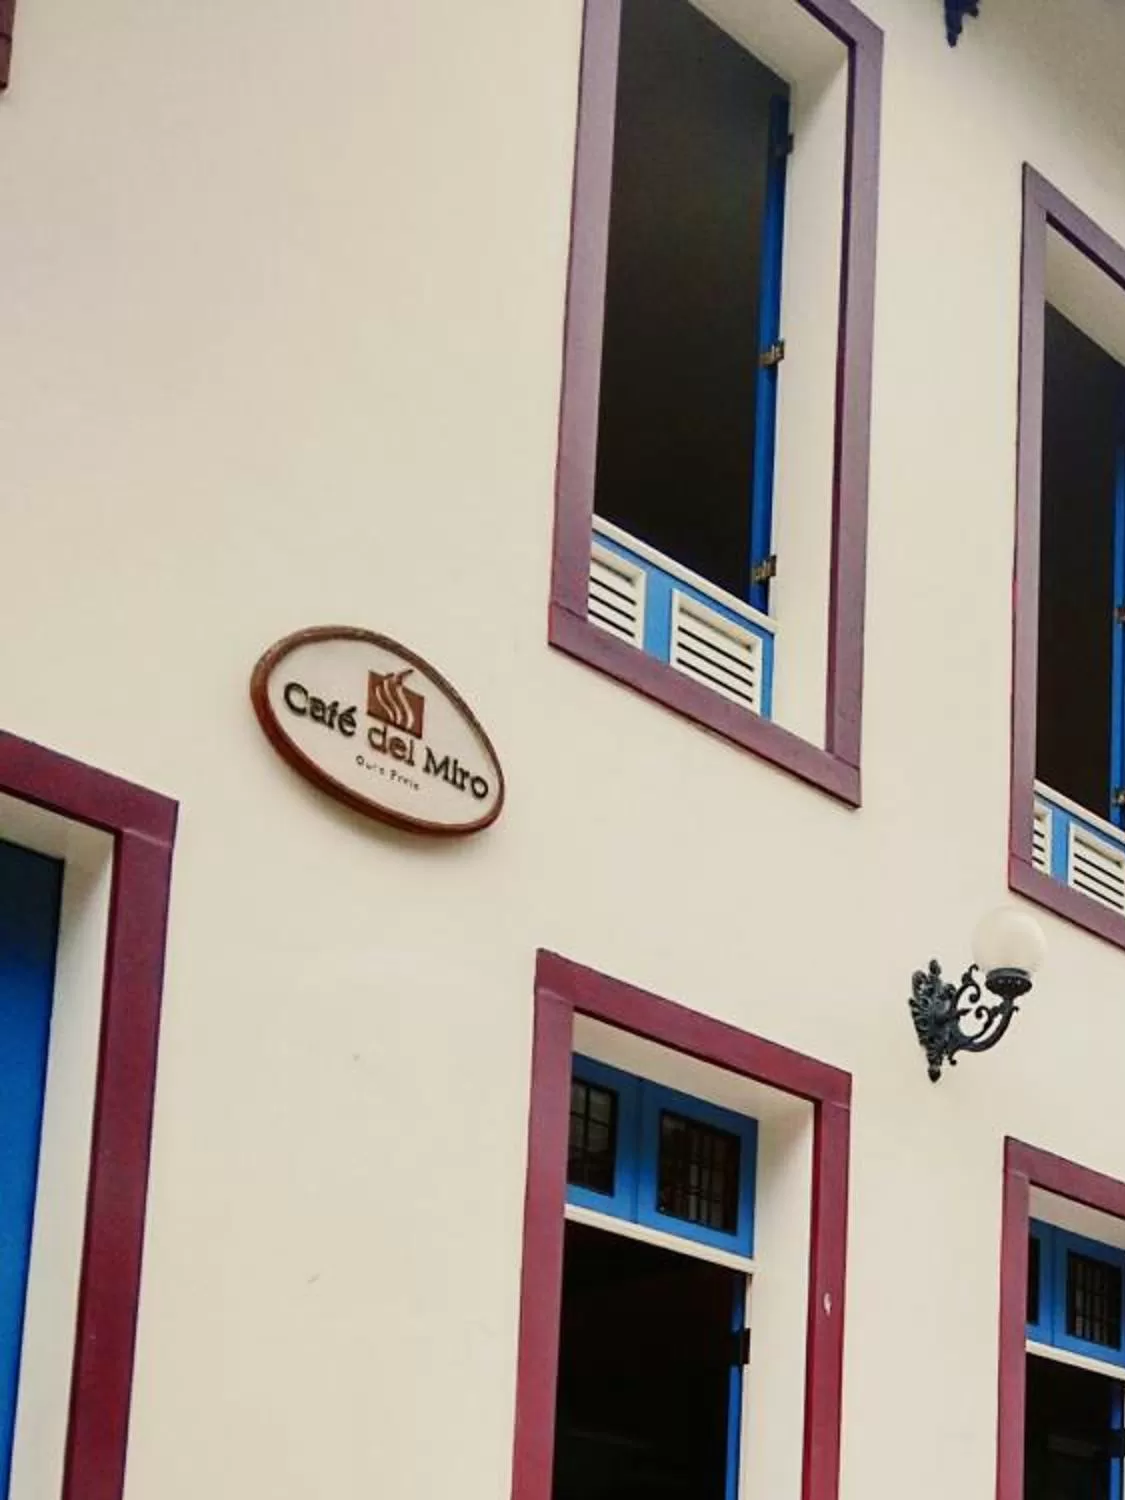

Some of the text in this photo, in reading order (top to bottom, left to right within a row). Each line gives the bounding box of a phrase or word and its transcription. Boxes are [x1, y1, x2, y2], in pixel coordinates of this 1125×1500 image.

[283, 682, 489, 799] Café del Miro
